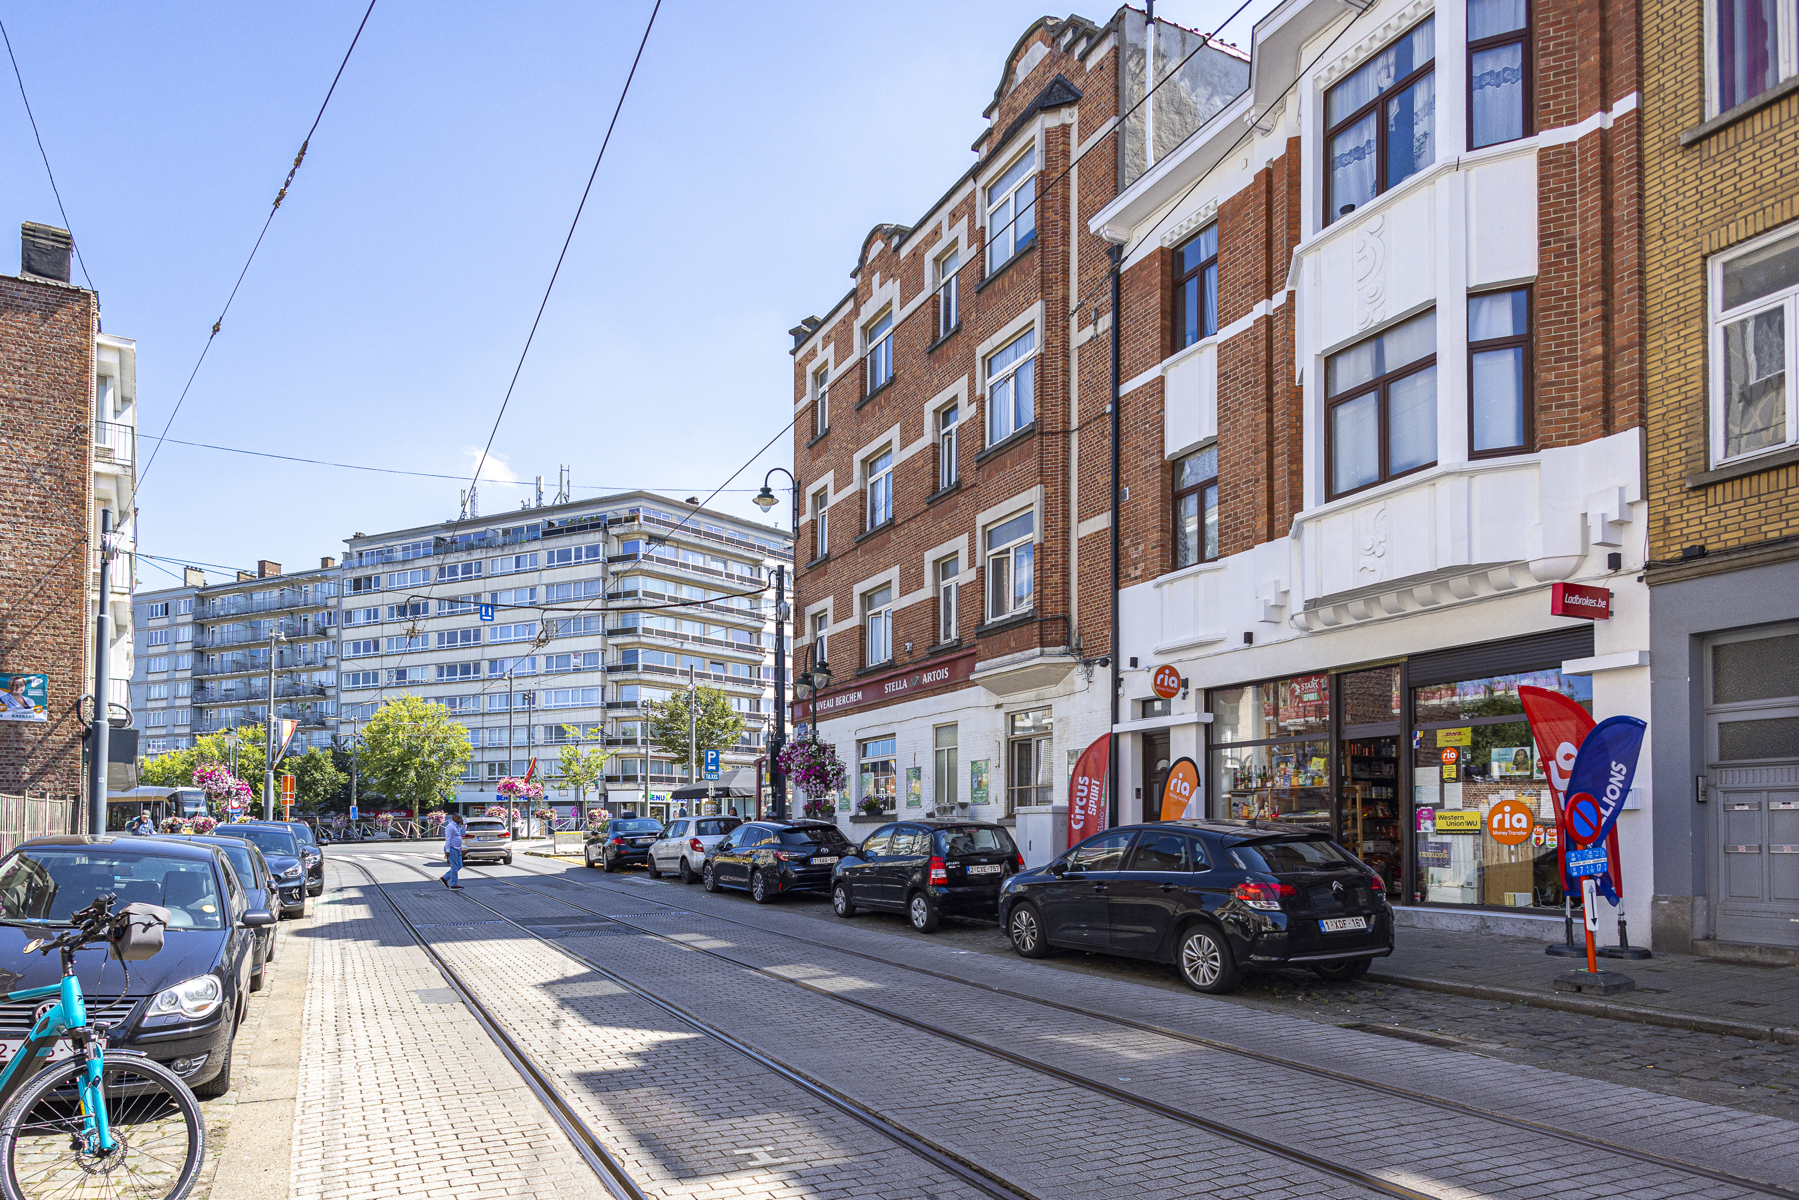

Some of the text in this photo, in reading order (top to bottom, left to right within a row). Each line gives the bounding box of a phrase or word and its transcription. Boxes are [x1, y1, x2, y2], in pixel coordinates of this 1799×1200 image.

[1564, 593, 1607, 608] Ladbrokes.be
[884, 667, 949, 694] STELLA ARTOIS
[1156, 669, 1179, 688] ria
[1301, 677, 1319, 691] STAR
[835, 690, 863, 706] BERCHEM
[707, 751, 717, 763] P
[1442, 749, 1457, 759] ria
[1170, 772, 1190, 797] ria
[1071, 775, 1090, 830] Circus
[1087, 777, 1100, 816] SPORT
[1492, 805, 1528, 829] ria
